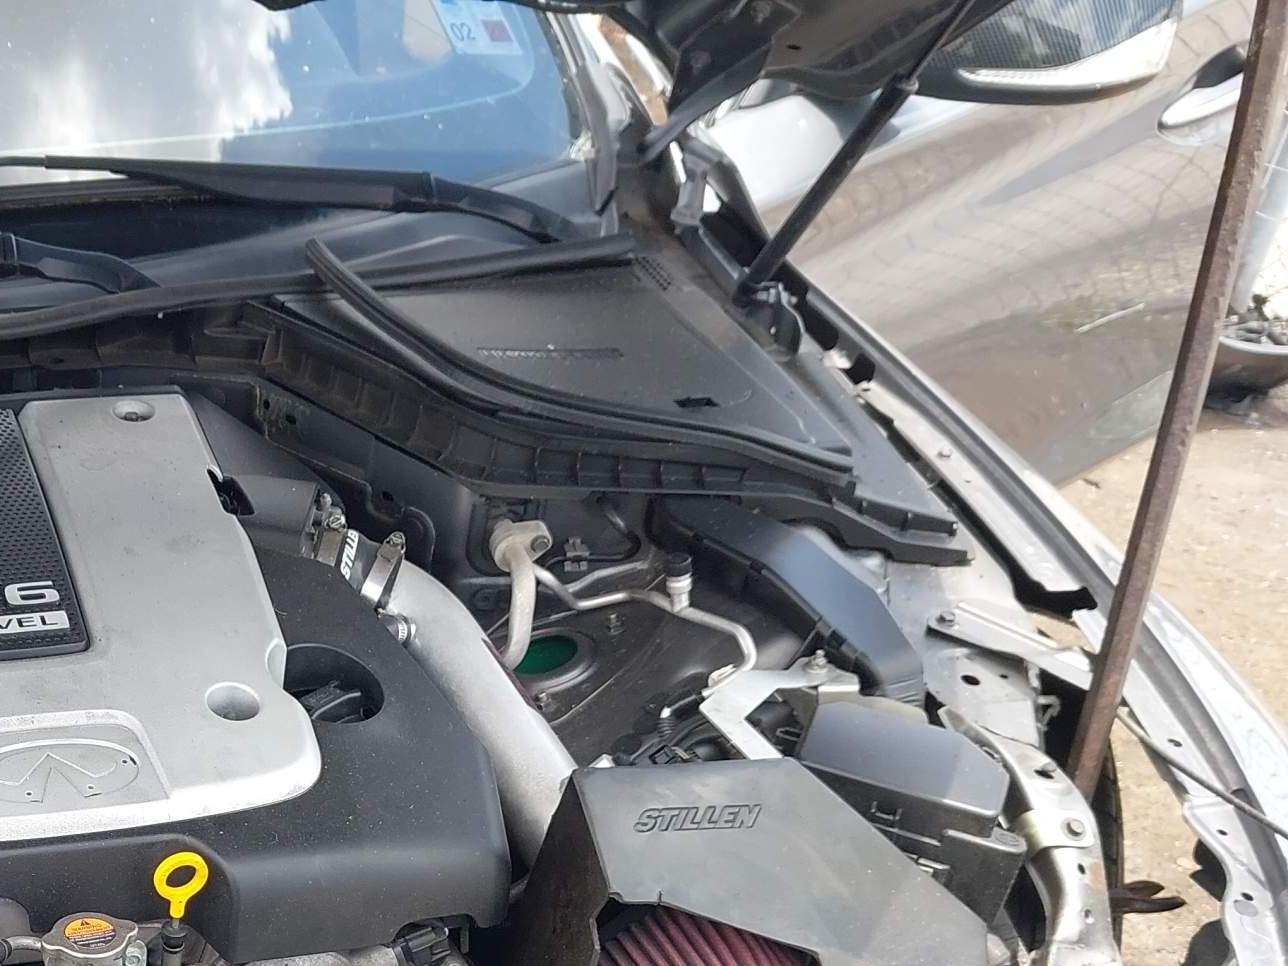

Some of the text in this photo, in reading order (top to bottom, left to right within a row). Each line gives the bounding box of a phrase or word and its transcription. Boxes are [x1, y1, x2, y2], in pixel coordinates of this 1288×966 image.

[450, 22, 476, 41] 02
[340, 528, 360, 581] STILLE
[632, 803, 762, 833] STILLEN
